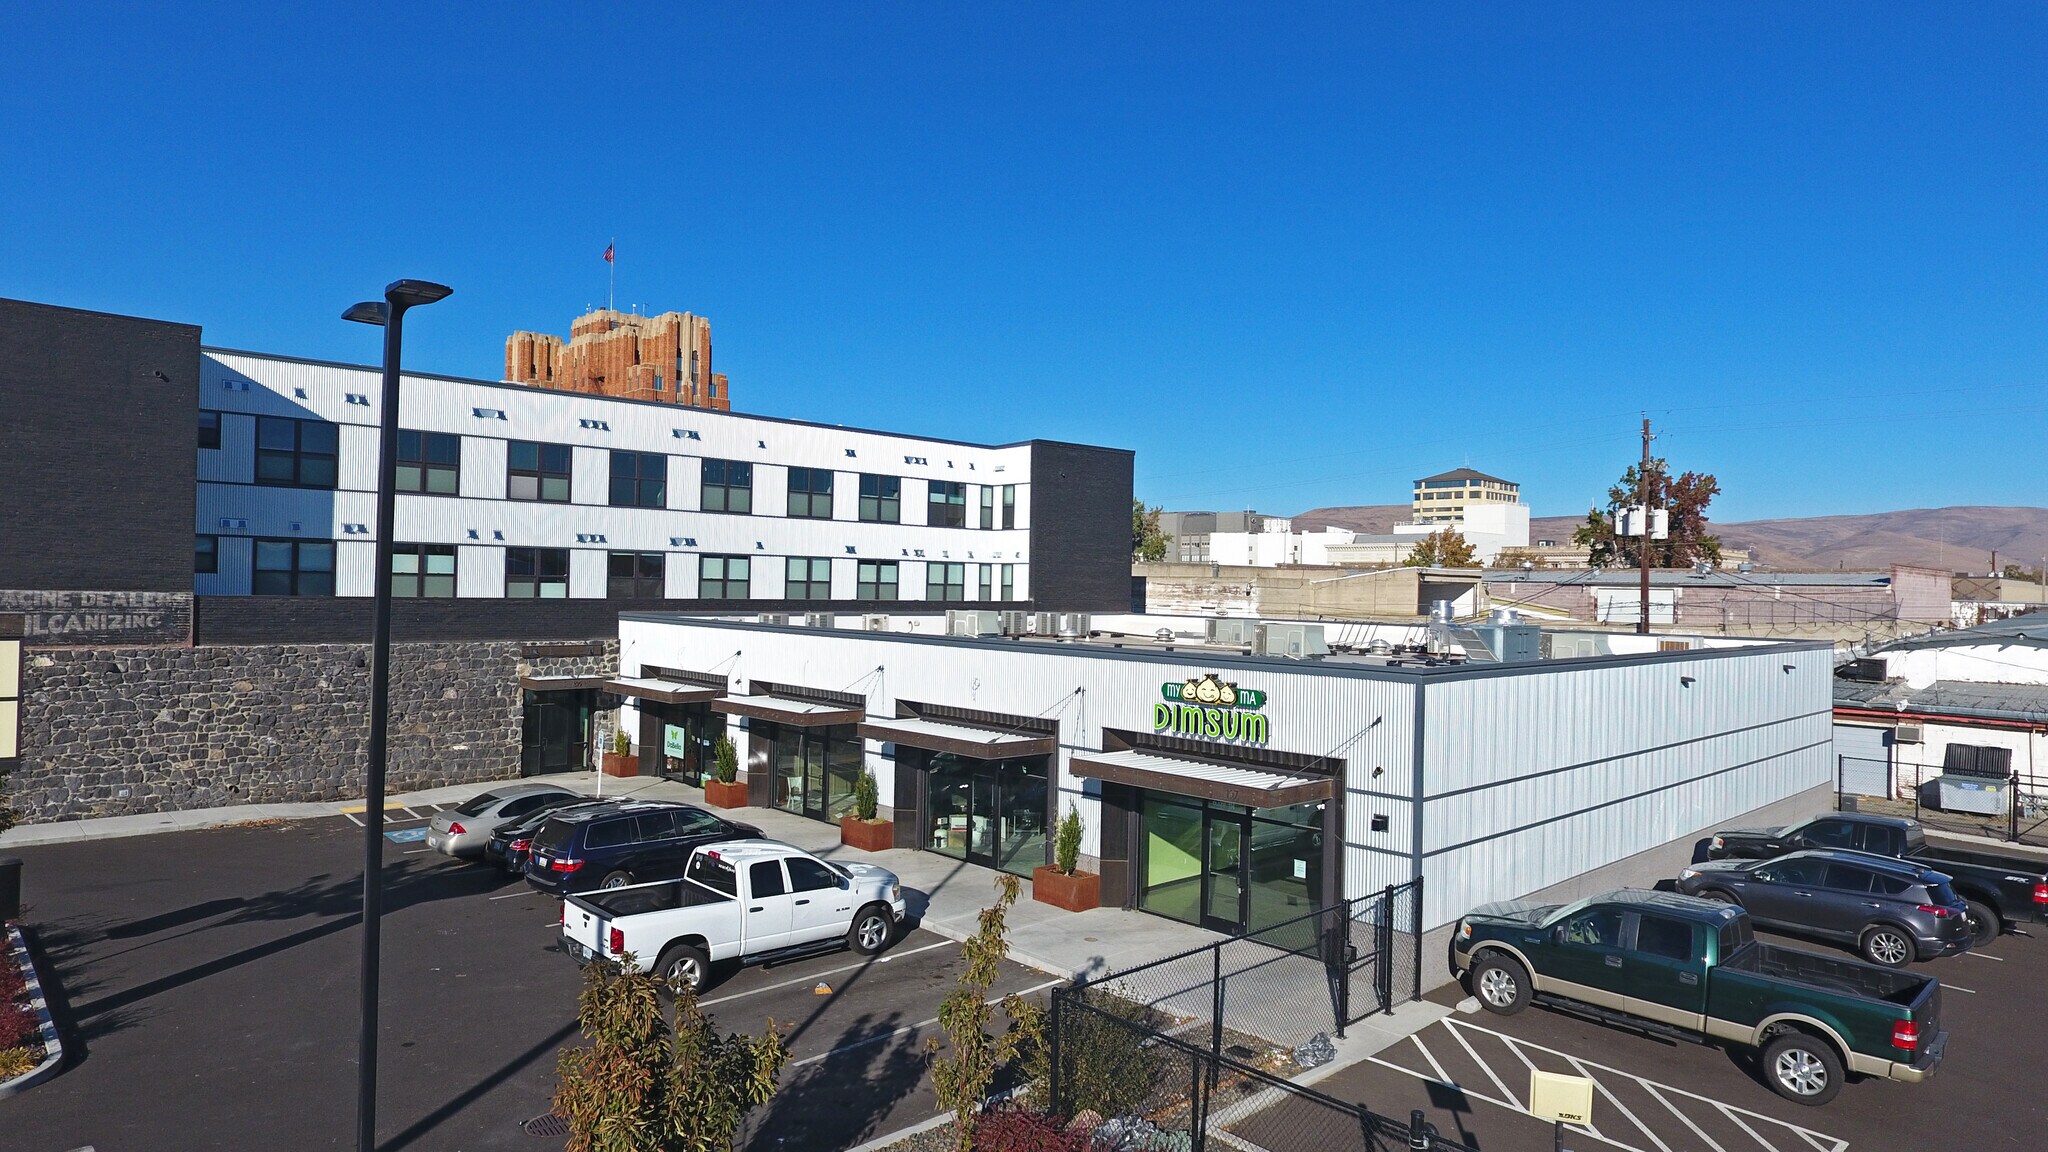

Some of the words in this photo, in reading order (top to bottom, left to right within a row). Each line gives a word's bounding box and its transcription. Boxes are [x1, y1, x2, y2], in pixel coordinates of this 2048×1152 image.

[1167, 683, 1181, 698] MY
[1240, 691, 1256, 705] MA
[1154, 703, 1266, 744] DIMSUM
